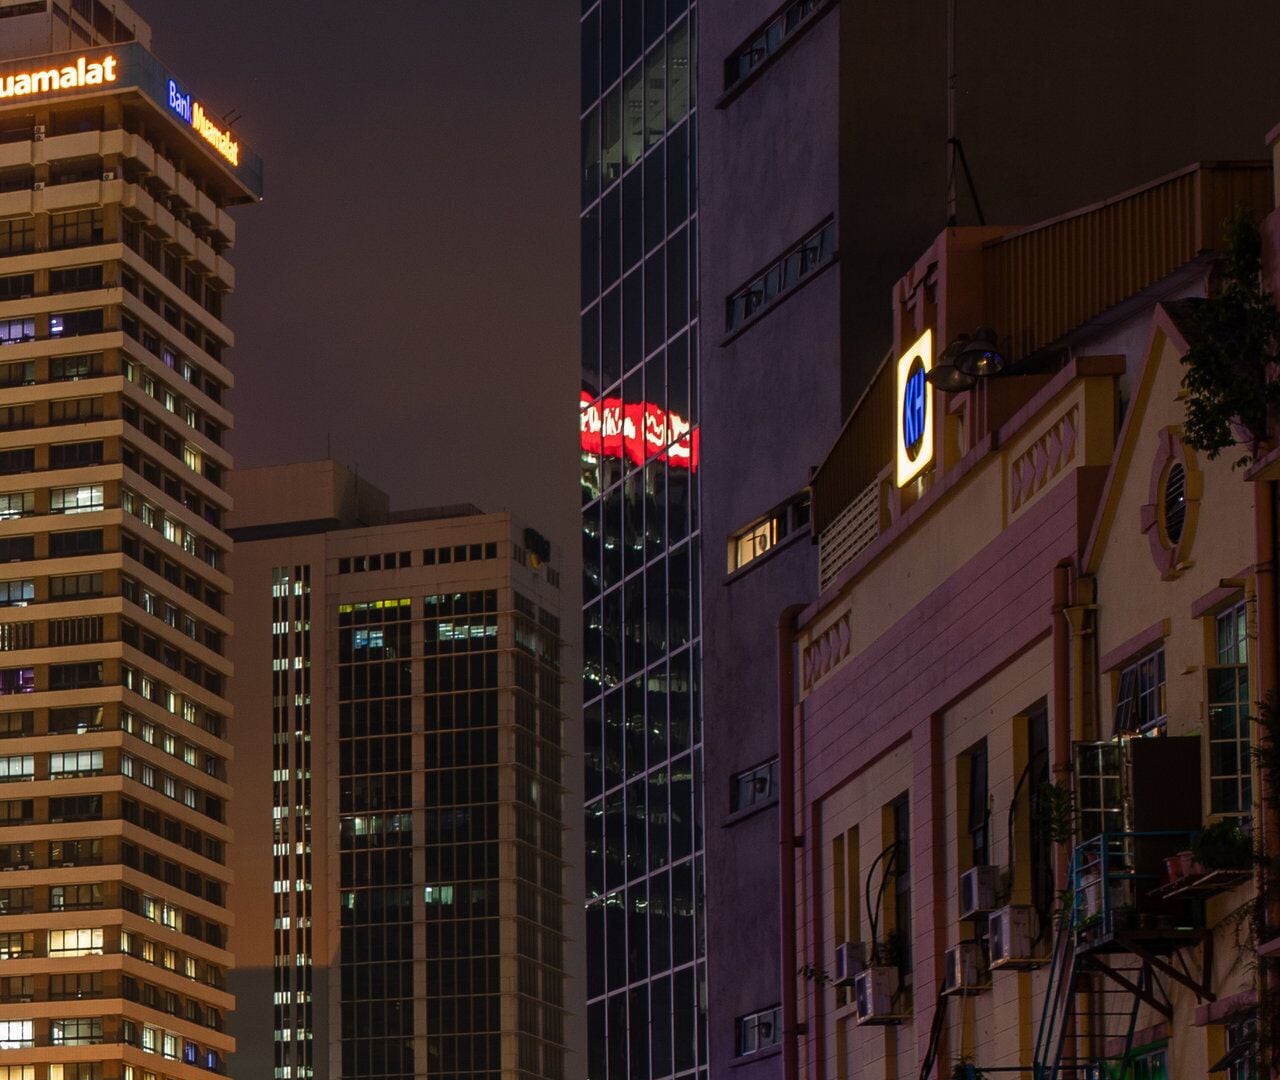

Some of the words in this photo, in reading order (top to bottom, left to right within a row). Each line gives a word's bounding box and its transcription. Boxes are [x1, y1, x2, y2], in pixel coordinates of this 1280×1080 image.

[169, 80, 193, 125] Bank
[192, 102, 239, 167] Muamalat
[905, 367, 926, 449] KH
